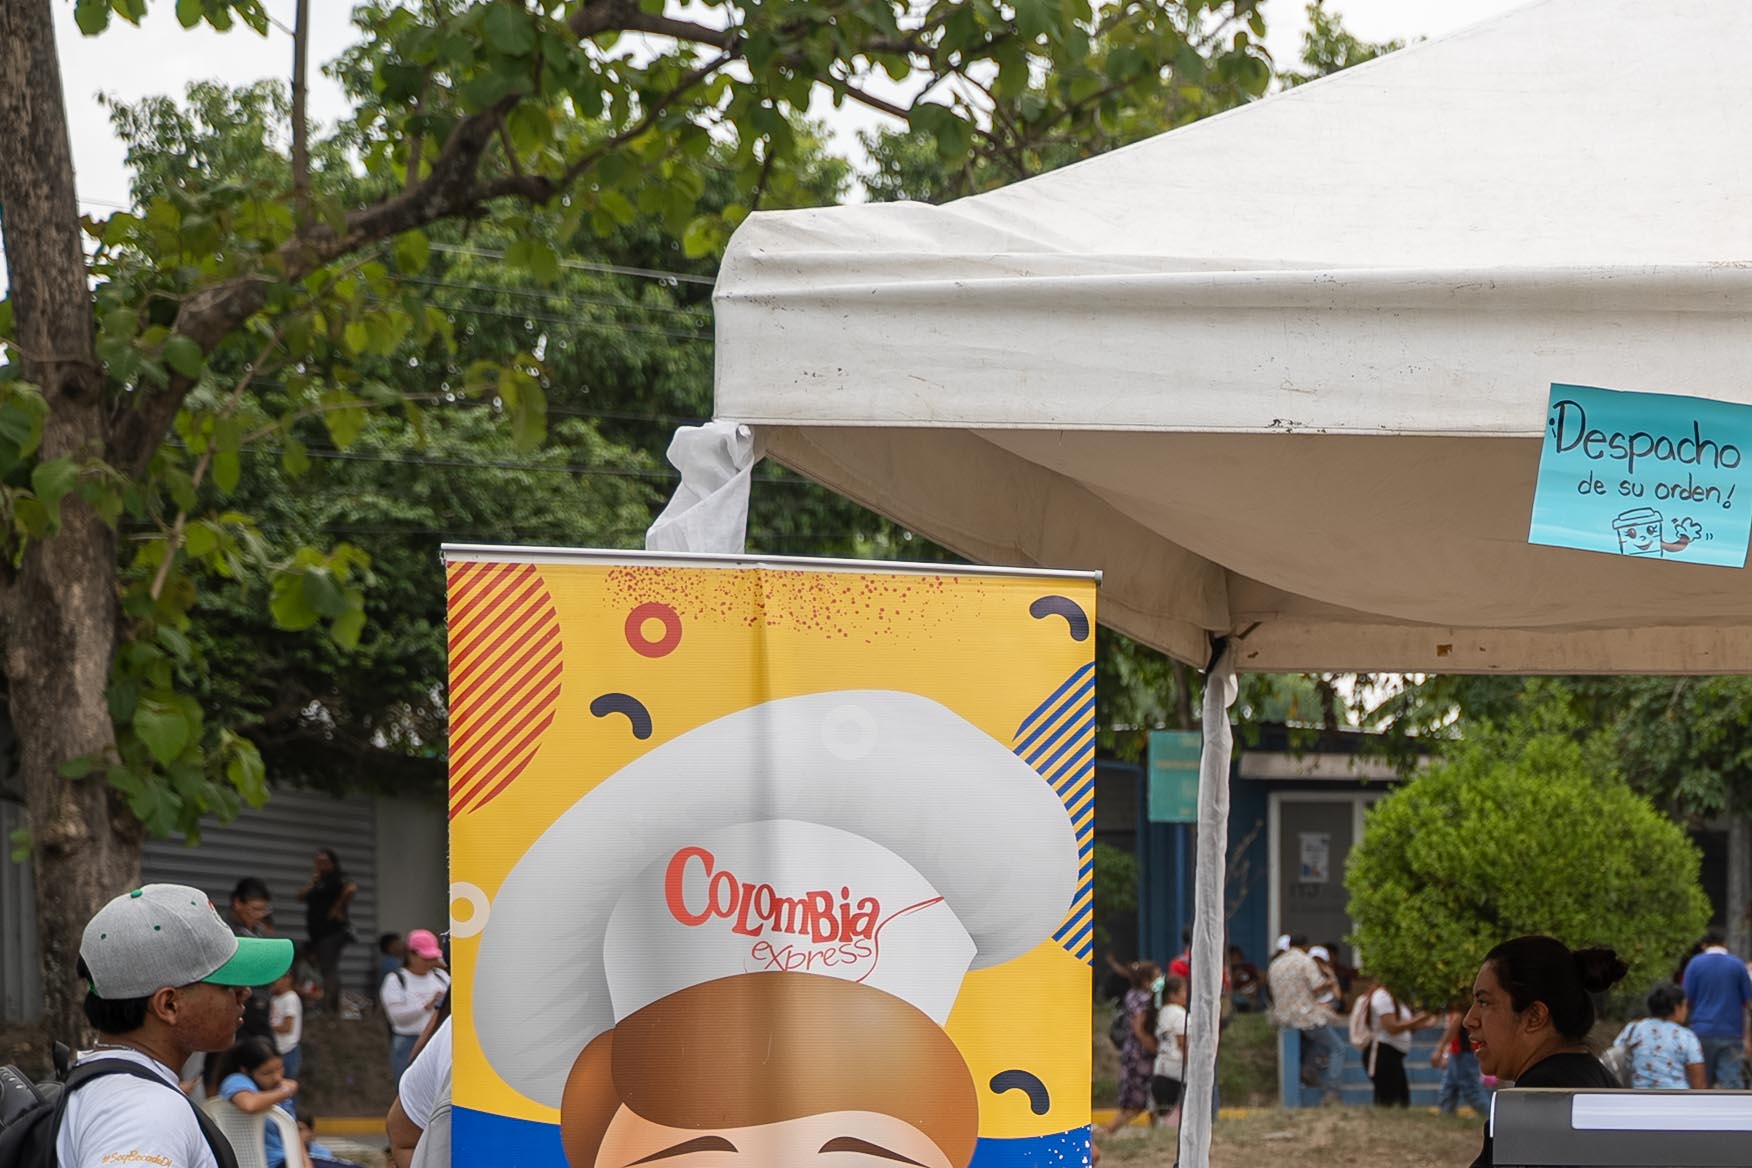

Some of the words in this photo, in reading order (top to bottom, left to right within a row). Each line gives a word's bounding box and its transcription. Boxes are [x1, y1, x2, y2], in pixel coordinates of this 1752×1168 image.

[1578, 471, 1606, 496] de
[1618, 480, 1644, 498] su
[1655, 473, 1736, 509] orden!
[751, 938, 872, 972] express
